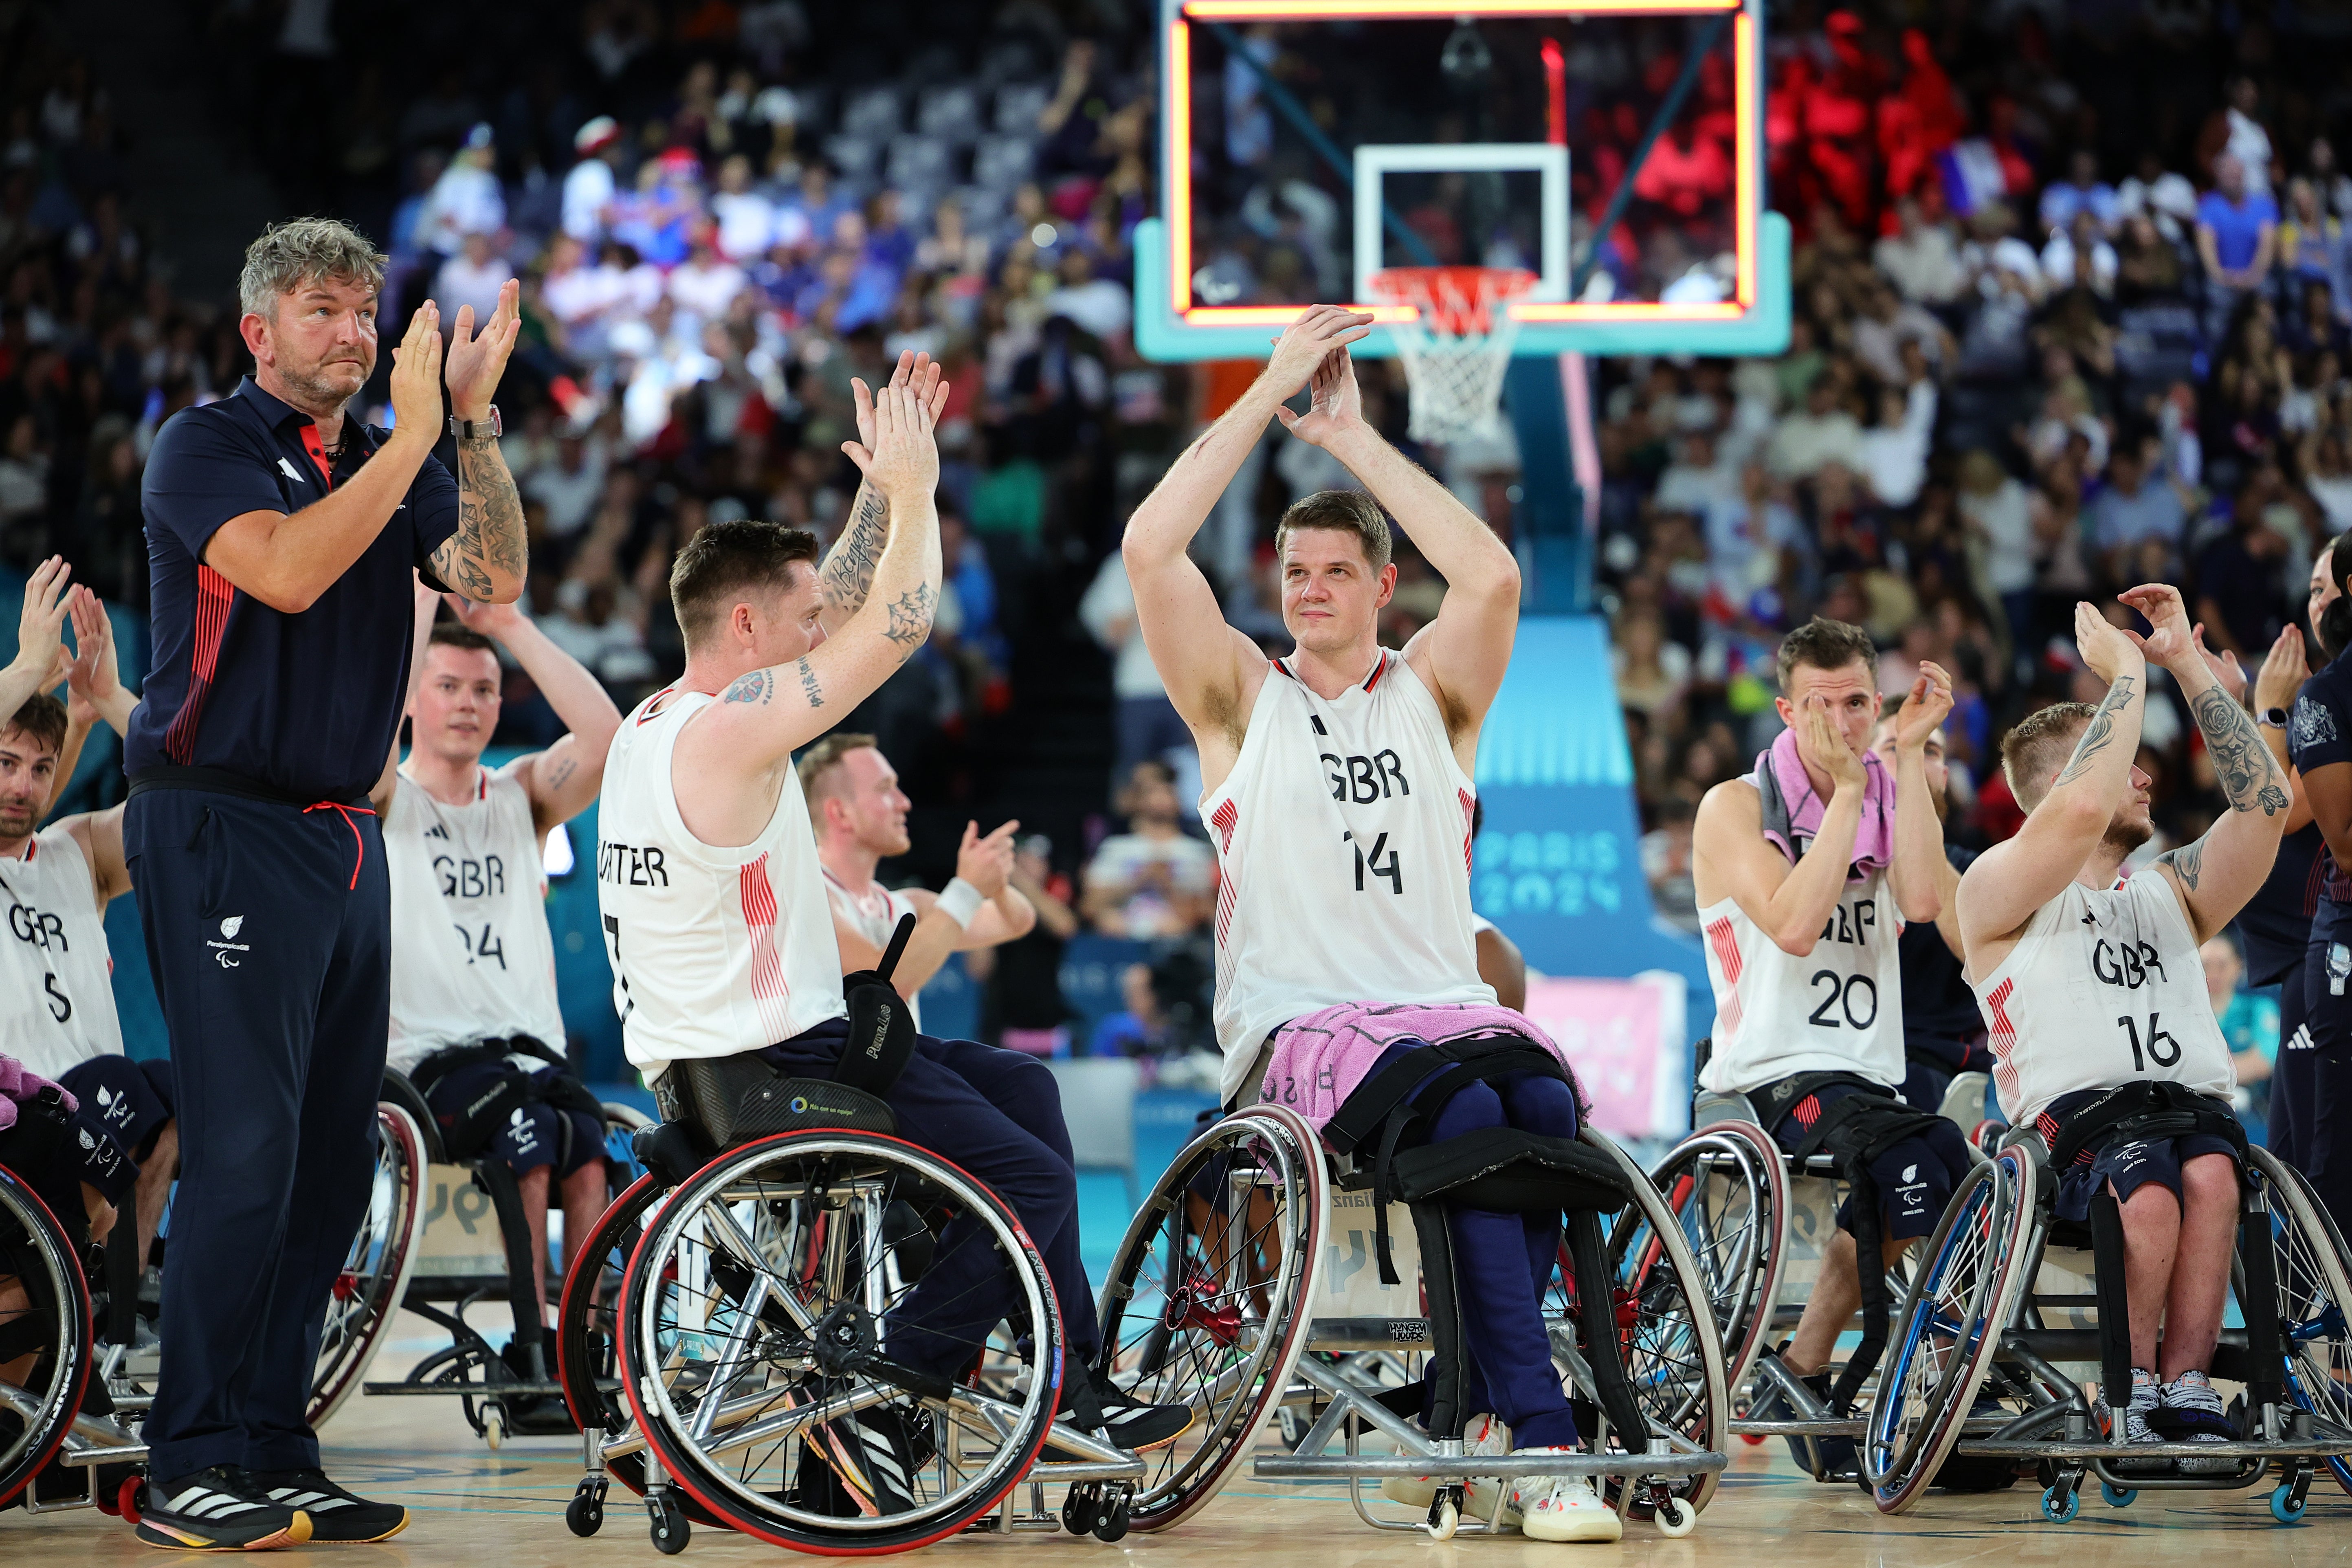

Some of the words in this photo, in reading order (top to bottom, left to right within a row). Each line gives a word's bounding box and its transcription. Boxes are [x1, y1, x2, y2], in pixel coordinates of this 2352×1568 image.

[1321, 749, 1410, 805] GBR
[433, 854, 505, 898] GBR
[1343, 831, 1403, 895] 14
[1477, 873, 1622, 918] 2024
[207, 940, 250, 951] ParalympicsGB
[2093, 938, 2168, 990] GBR
[44, 972, 71, 1023] 5
[1809, 970, 1877, 1030] 20
[2118, 1012, 2181, 1071] 16
[85, 1134, 108, 1166] ParalympicsGB
[2123, 1162, 2134, 1173] PARIS
[1051, 1317, 1062, 1346] PRO
[1388, 1322, 1427, 1335] HUNGRY
[1393, 1331, 1425, 1343] HOOPS
